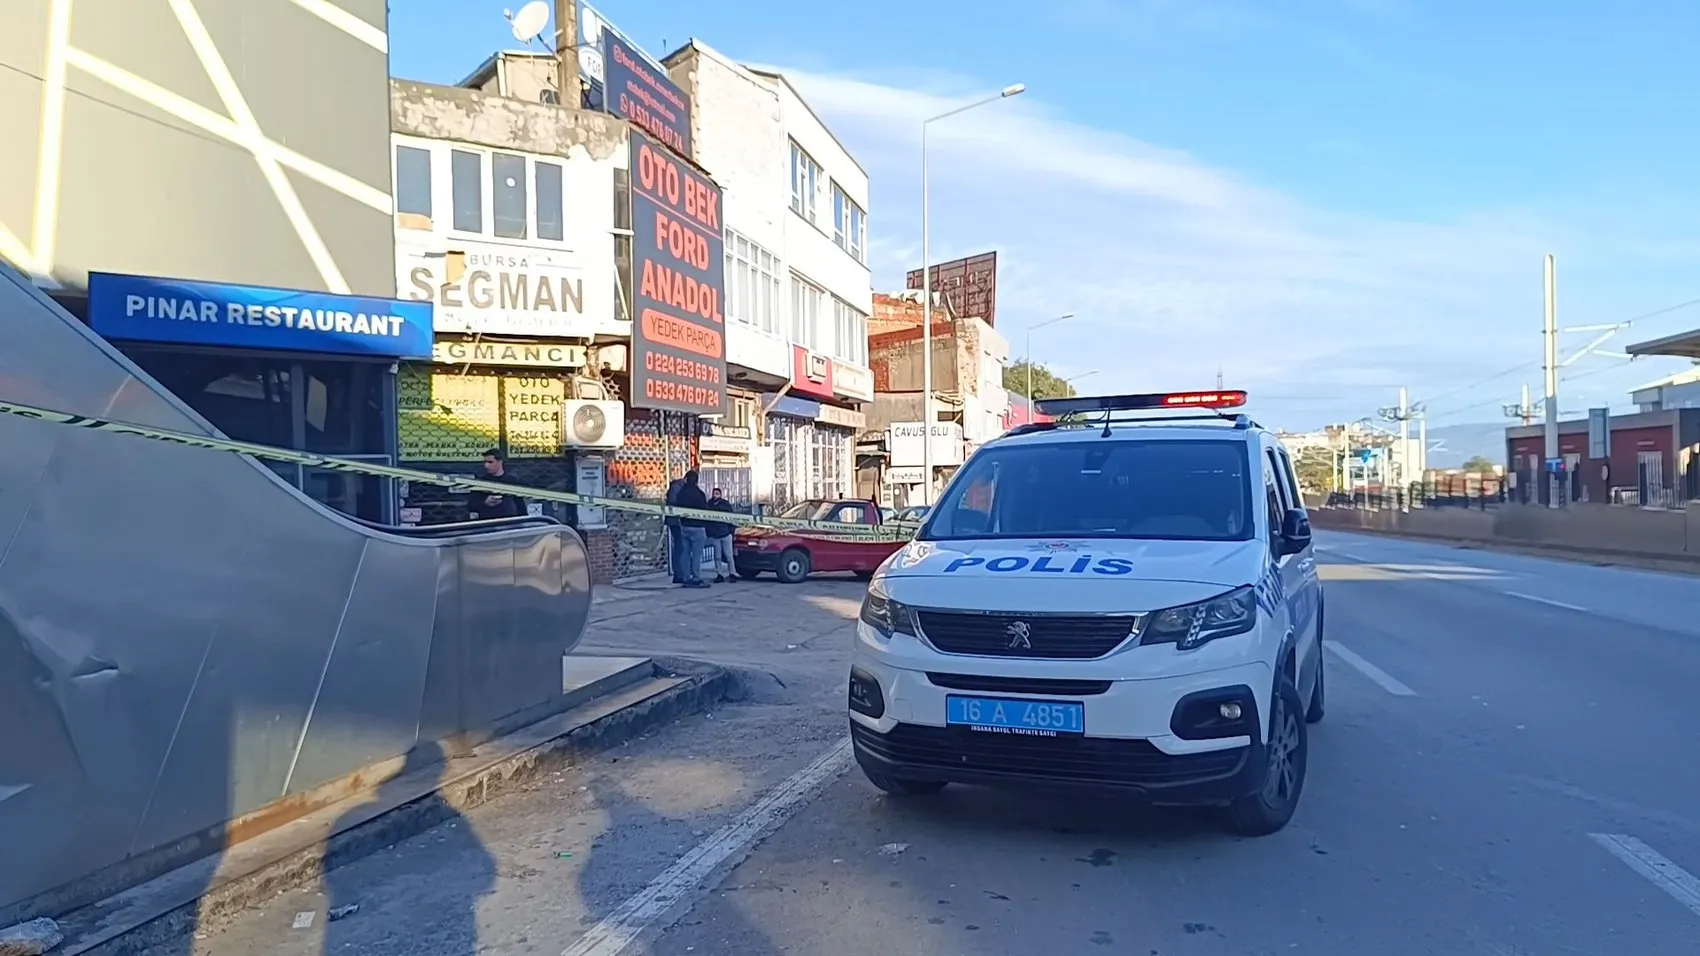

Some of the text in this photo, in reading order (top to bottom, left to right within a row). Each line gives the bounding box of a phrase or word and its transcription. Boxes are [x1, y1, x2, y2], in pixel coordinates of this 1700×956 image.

[636, 105, 650, 130] 533
[640, 144, 719, 231] OTO BEK
[656, 211, 709, 271] FORD
[470, 254, 529, 268] BURSA
[410, 266, 583, 314] SEGMAN
[640, 258, 723, 324] ANADOL
[125, 294, 405, 337] PINAR RESTAURANT
[650, 315, 716, 353] YEDEK PARÇA
[520, 377, 550, 389] OTO
[646, 351, 719, 384] 0 224 253 69 78
[509, 393, 561, 406] YEDEK
[646, 379, 719, 407] 0 533 476 07 24
[944, 555, 1133, 575] POLİS
[961, 700, 1077, 729] 16 A 4851
